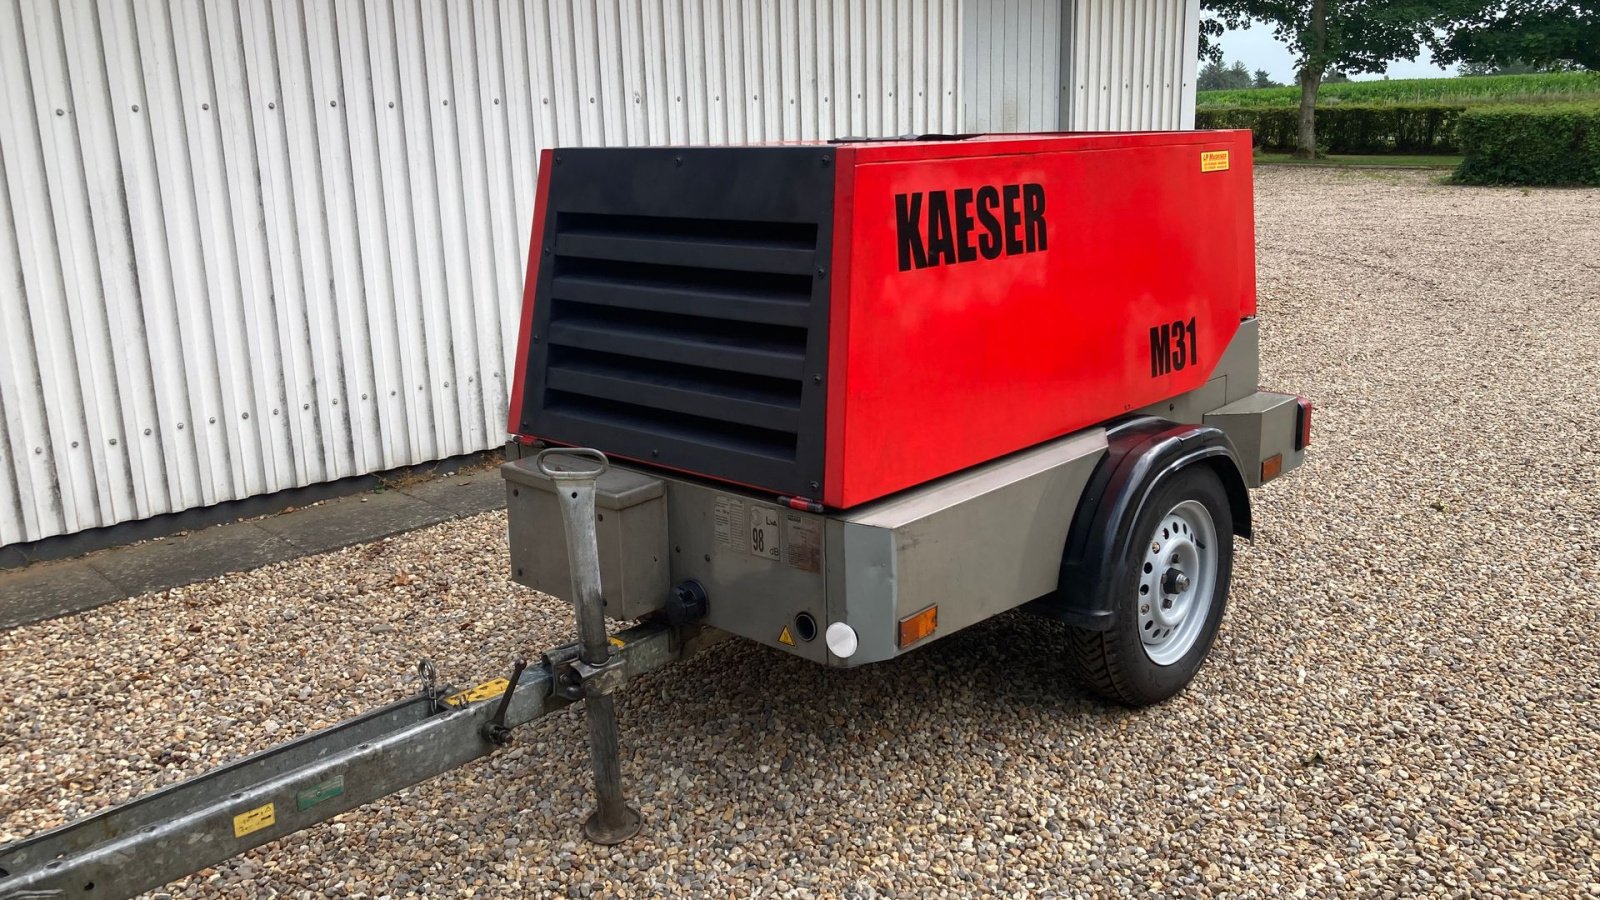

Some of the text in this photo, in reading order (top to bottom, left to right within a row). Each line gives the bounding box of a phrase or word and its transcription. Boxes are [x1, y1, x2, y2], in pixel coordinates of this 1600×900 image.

[895, 183, 1048, 272] KAESER
[1150, 316, 1197, 378] M31
[752, 527, 764, 552] 98
[769, 547, 779, 556] dB
